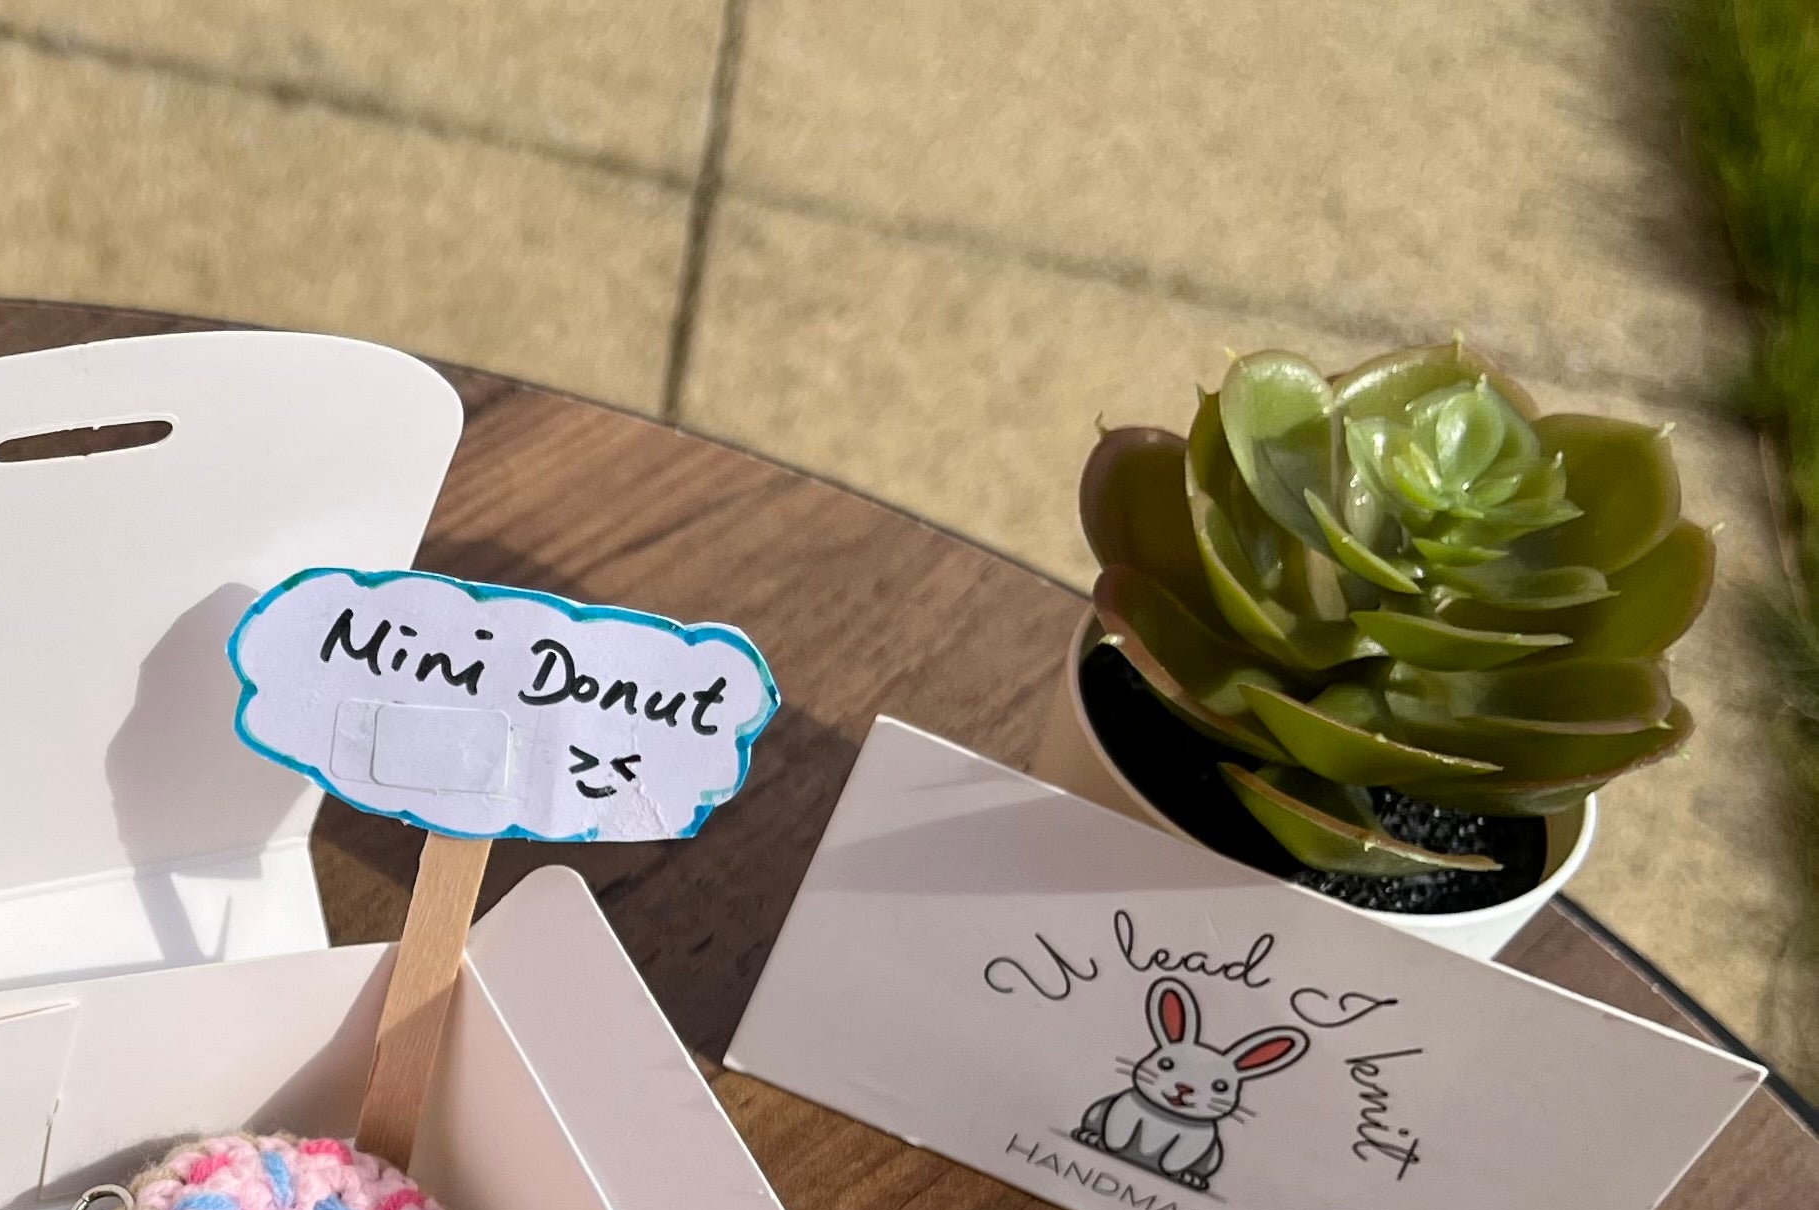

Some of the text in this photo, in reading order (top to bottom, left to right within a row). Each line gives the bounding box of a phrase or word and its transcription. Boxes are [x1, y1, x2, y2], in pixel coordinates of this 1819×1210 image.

[320, 608, 727, 735] Mini Donut
[983, 932, 1098, 1001] U
[1113, 910, 1275, 988] lead
[1343, 1047, 1423, 1181] knit
